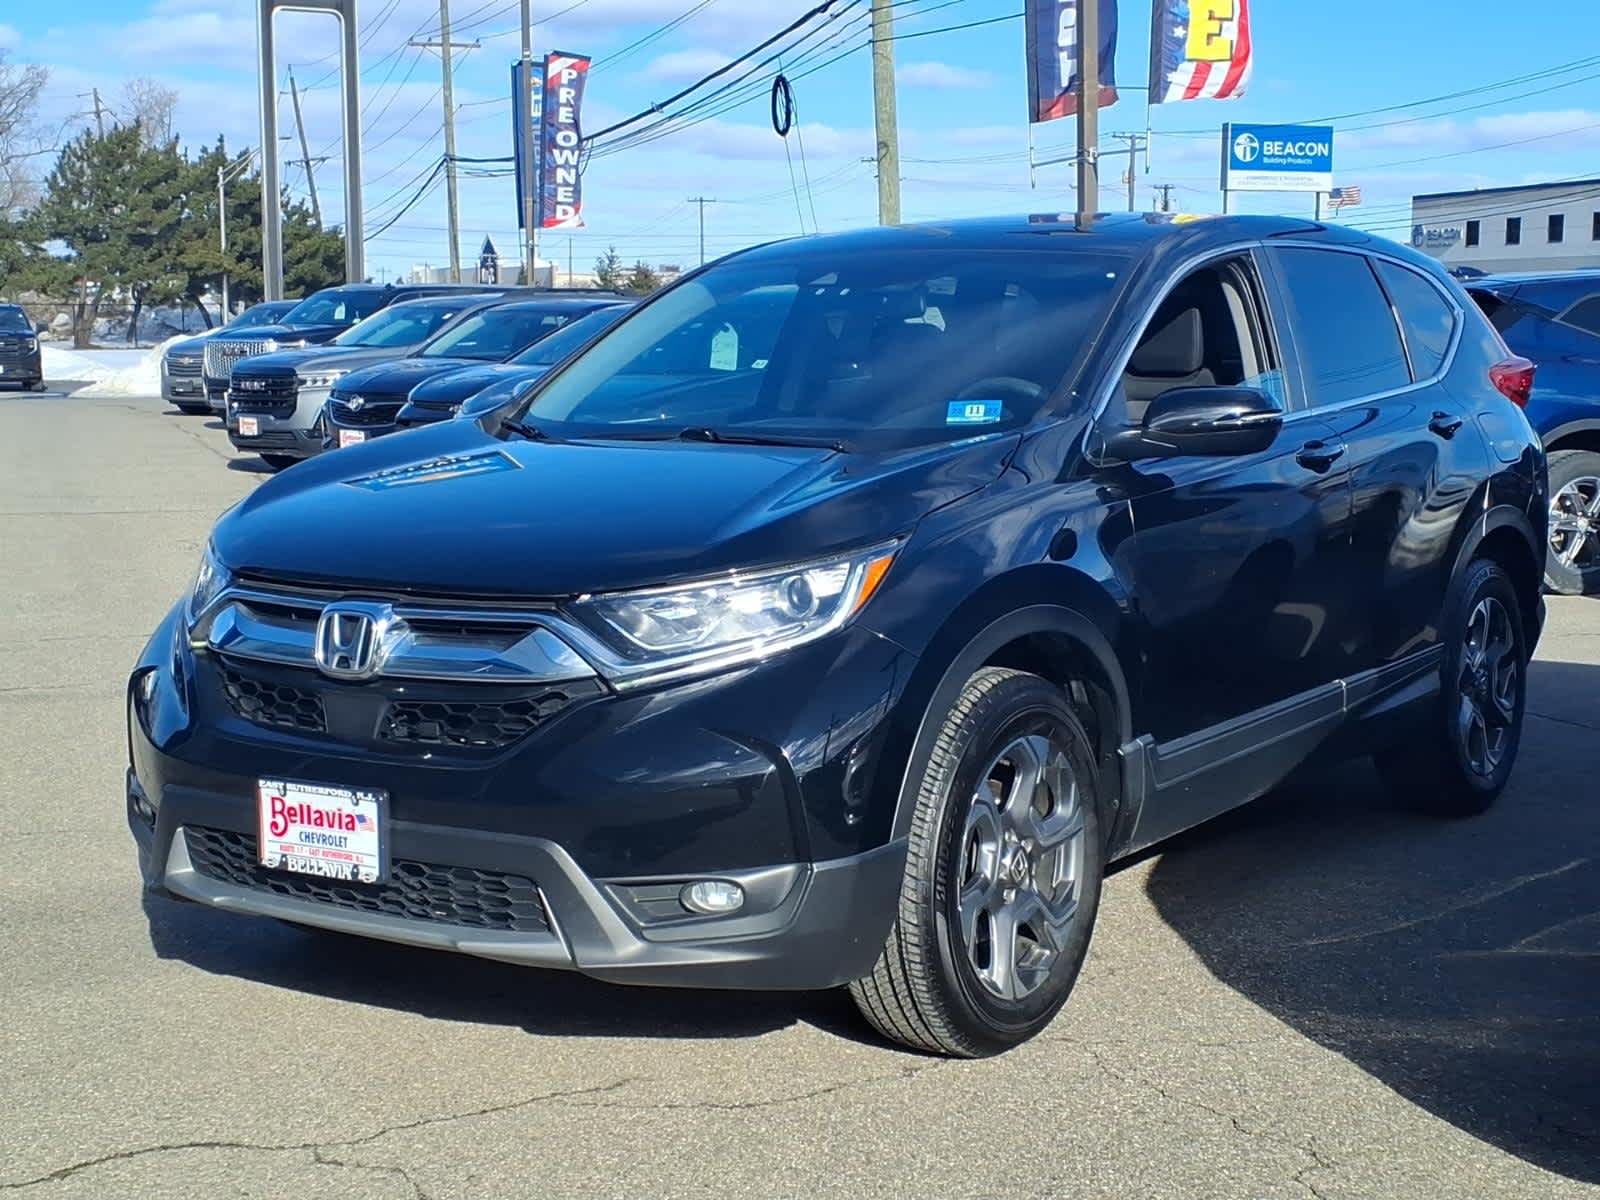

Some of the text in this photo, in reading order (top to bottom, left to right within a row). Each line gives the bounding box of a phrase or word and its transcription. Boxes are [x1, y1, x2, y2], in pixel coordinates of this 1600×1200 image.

[552, 68, 579, 220] PRE OWNED
[1263, 141, 1329, 157] BEACON
[270, 796, 356, 837] Bellavia
[298, 831, 348, 849] CHEVROLET
